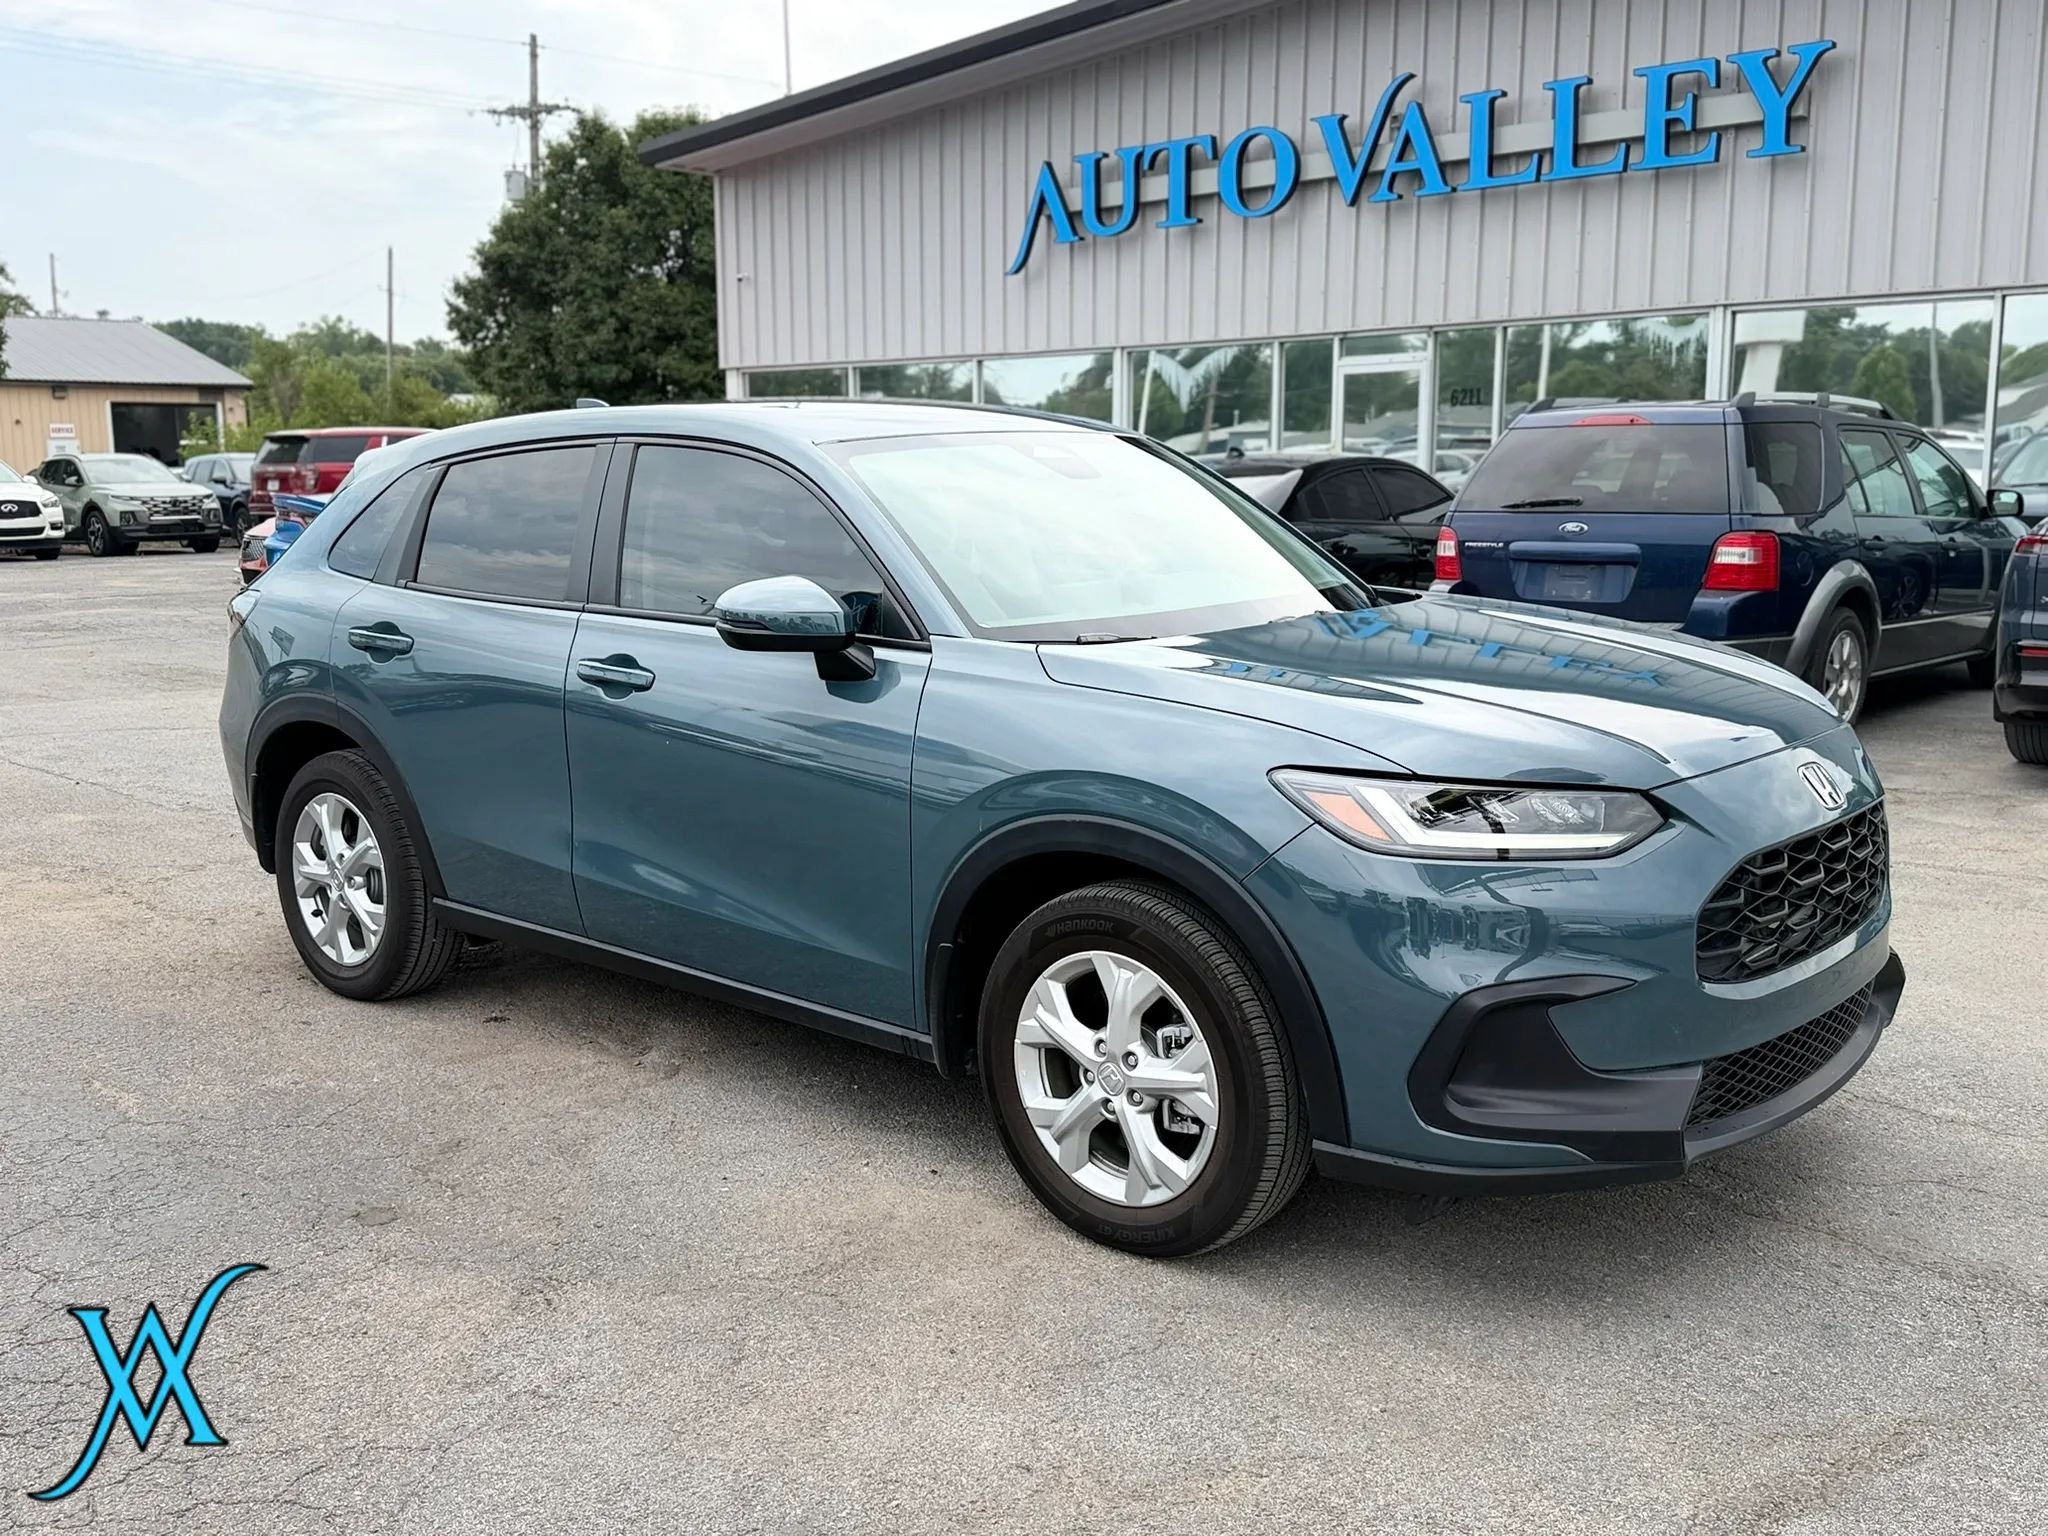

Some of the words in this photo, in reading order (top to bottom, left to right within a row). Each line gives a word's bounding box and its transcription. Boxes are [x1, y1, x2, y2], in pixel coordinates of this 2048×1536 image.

[1005, 126, 1300, 275] AUTO
[1311, 38, 1837, 206] VALLEY
[1450, 387, 1482, 407] 6211
